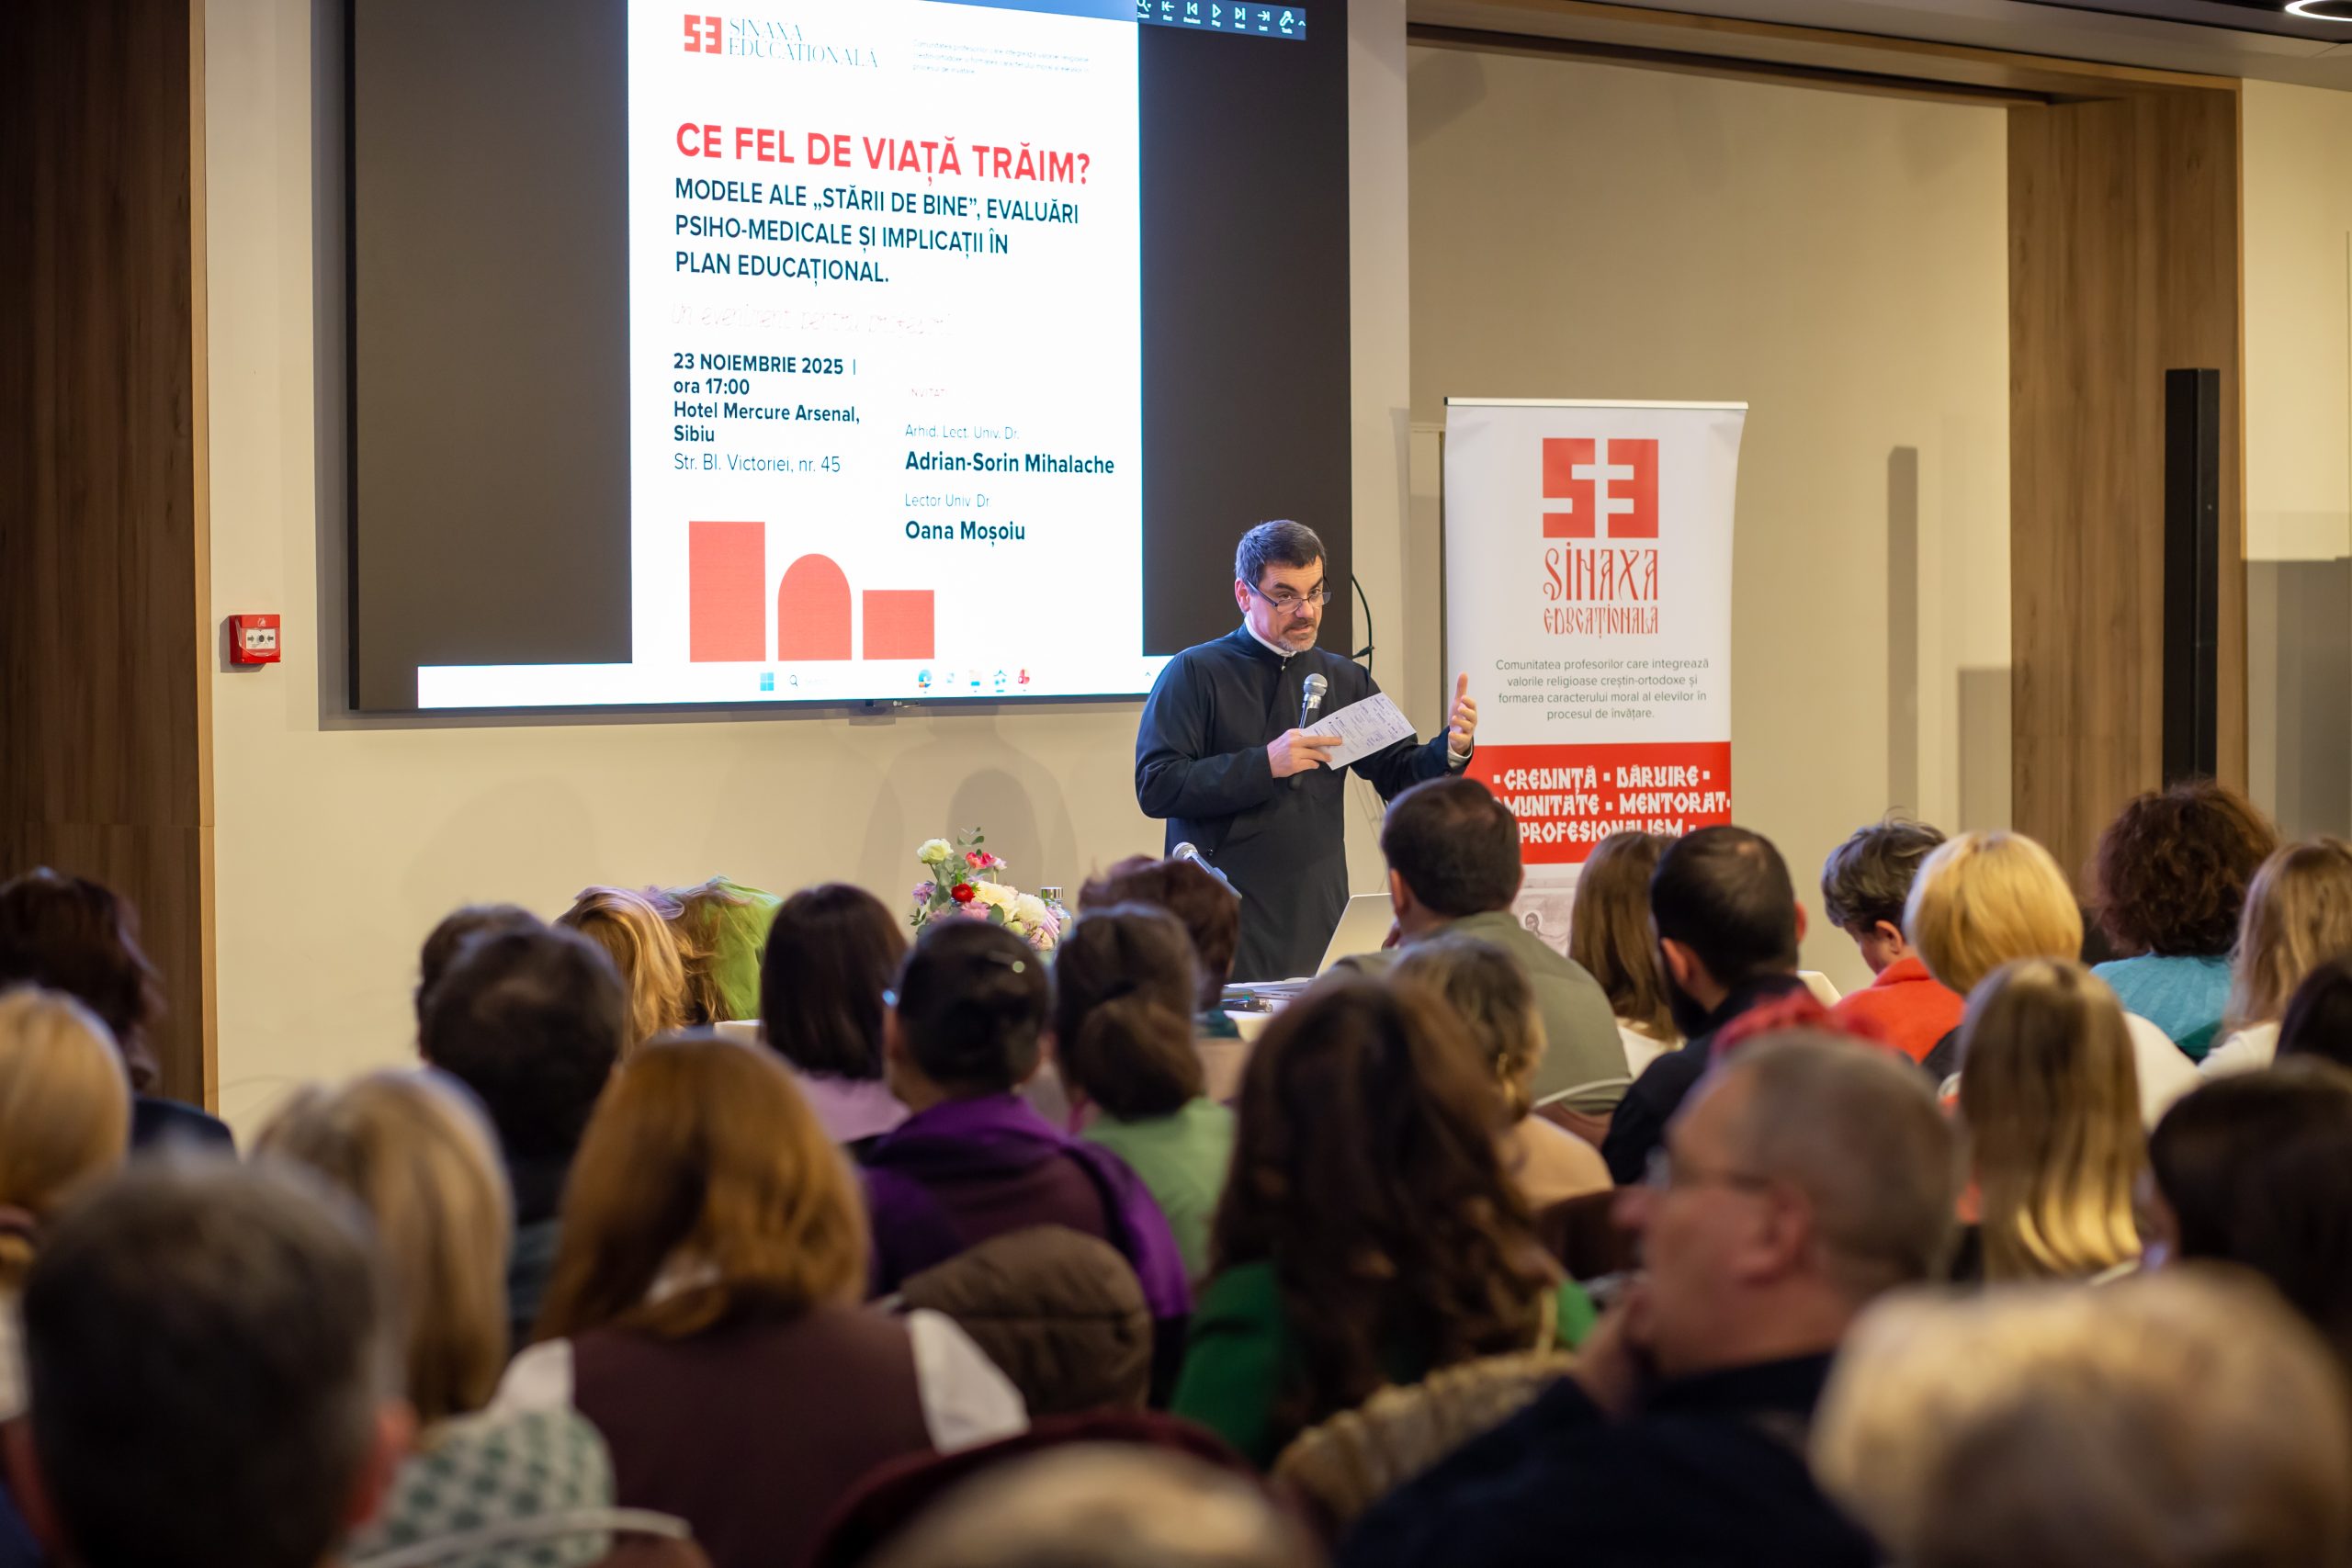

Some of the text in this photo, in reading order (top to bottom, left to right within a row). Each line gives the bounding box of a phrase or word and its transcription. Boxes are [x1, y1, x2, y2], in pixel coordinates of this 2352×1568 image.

[676, 123, 1091, 186] CE FEL DE VIAȚĂ TRĂIM?
[675, 177, 763, 204] MODELE
[769, 184, 807, 207] ALE
[891, 191, 917, 214] DE
[987, 197, 1079, 224] EVALUĂRI
[675, 214, 1009, 259] PSIHO-MEDICALE ȘI IMPLICAȚII ÎN
[675, 251, 889, 287] PLAN EDUCAȚIONAL.
[673, 353, 695, 370] 23
[700, 354, 797, 373] NOIEMBRIE
[801, 357, 844, 375] 2025
[673, 378, 750, 395] ora 17:00
[673, 400, 860, 424] Hotel Mercure Arsenal,
[673, 424, 715, 442] Sibiu
[904, 423, 940, 438] Arhid.
[674, 453, 841, 474] Str. Bl. Victoriei, nr. 45
[904, 450, 1115, 475] Adrian-Sorin Mihalache
[904, 493, 941, 508] Lector
[905, 520, 1025, 547] Oana Moșoiu
[1496, 658, 1709, 671] Comunitatea profesorilor care integrează
[1507, 674, 1698, 689] valorile religioase creștin-ortodoxe și
[1498, 693, 1544, 704] formarea
[1546, 691, 1608, 703] caracterului
[1611, 691, 1639, 702] moral
[1642, 691, 1651, 702] al
[1654, 691, 1694, 702] elevilor
[1546, 708, 1592, 722] procesul
[1595, 708, 1609, 719] de
[1503, 764, 1699, 795] CREDINȚĂ DĂRUIRE
[1493, 791, 1726, 818] MUNITATE MENTORAT
